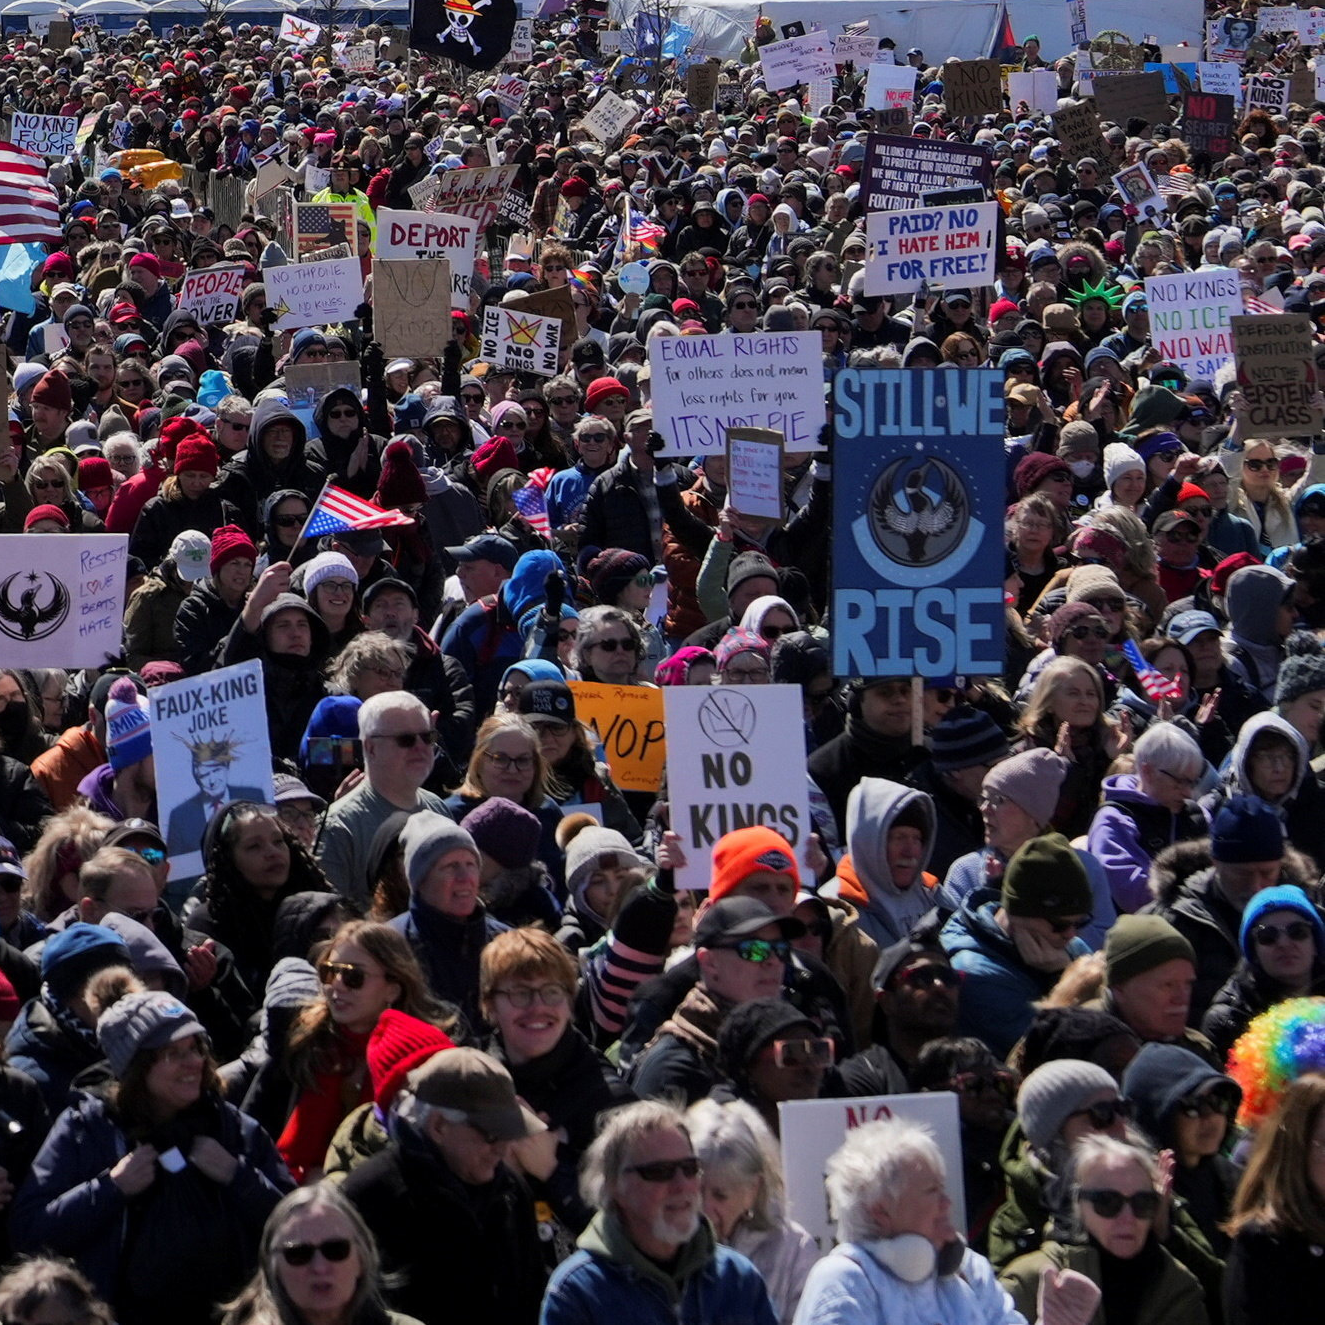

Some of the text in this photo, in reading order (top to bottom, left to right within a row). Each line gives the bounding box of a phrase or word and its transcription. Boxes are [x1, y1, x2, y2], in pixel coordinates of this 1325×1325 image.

[1252, 77, 1285, 89] NO
[1188, 96, 1218, 120] NO
[1250, 87, 1284, 105] KINGS
[14, 115, 74, 133] NO KING
[20, 129, 72, 143] FUCK
[1186, 120, 1228, 136] SECRET
[12, 138, 75, 153] TRUMP
[875, 145, 982, 165] MILLIONS OF AMERICANS HAVE DIED
[882, 156, 972, 176] TO PROTECT OUR DEMOCRACY.
[889, 209, 978, 235] PAID? NO
[390, 223, 470, 247] DEPORT
[878, 231, 980, 255] I HATE HIM
[887, 253, 988, 281] FOR FREE!
[186, 271, 244, 299] PEOPLE
[1151, 278, 1237, 302] NO KINGS
[1155, 311, 1183, 332] NO
[484, 311, 500, 359] NO ICE
[543, 322, 559, 370] NO WAR
[506, 344, 534, 359] NO
[661, 335, 799, 361] EQUAL RIGHTS
[1160, 337, 1191, 359] NO
[504, 355, 534, 370] KINGS
[664, 365, 809, 383] for others does not mean
[680, 387, 800, 409] less rights for you
[835, 369, 1004, 438] STILL WE
[670, 411, 810, 449] IT'S PIE
[834, 587, 1003, 677] RISE
[156, 673, 258, 722] FAUX-KING
[188, 707, 229, 735] JOKE
[702, 751, 753, 789] NO
